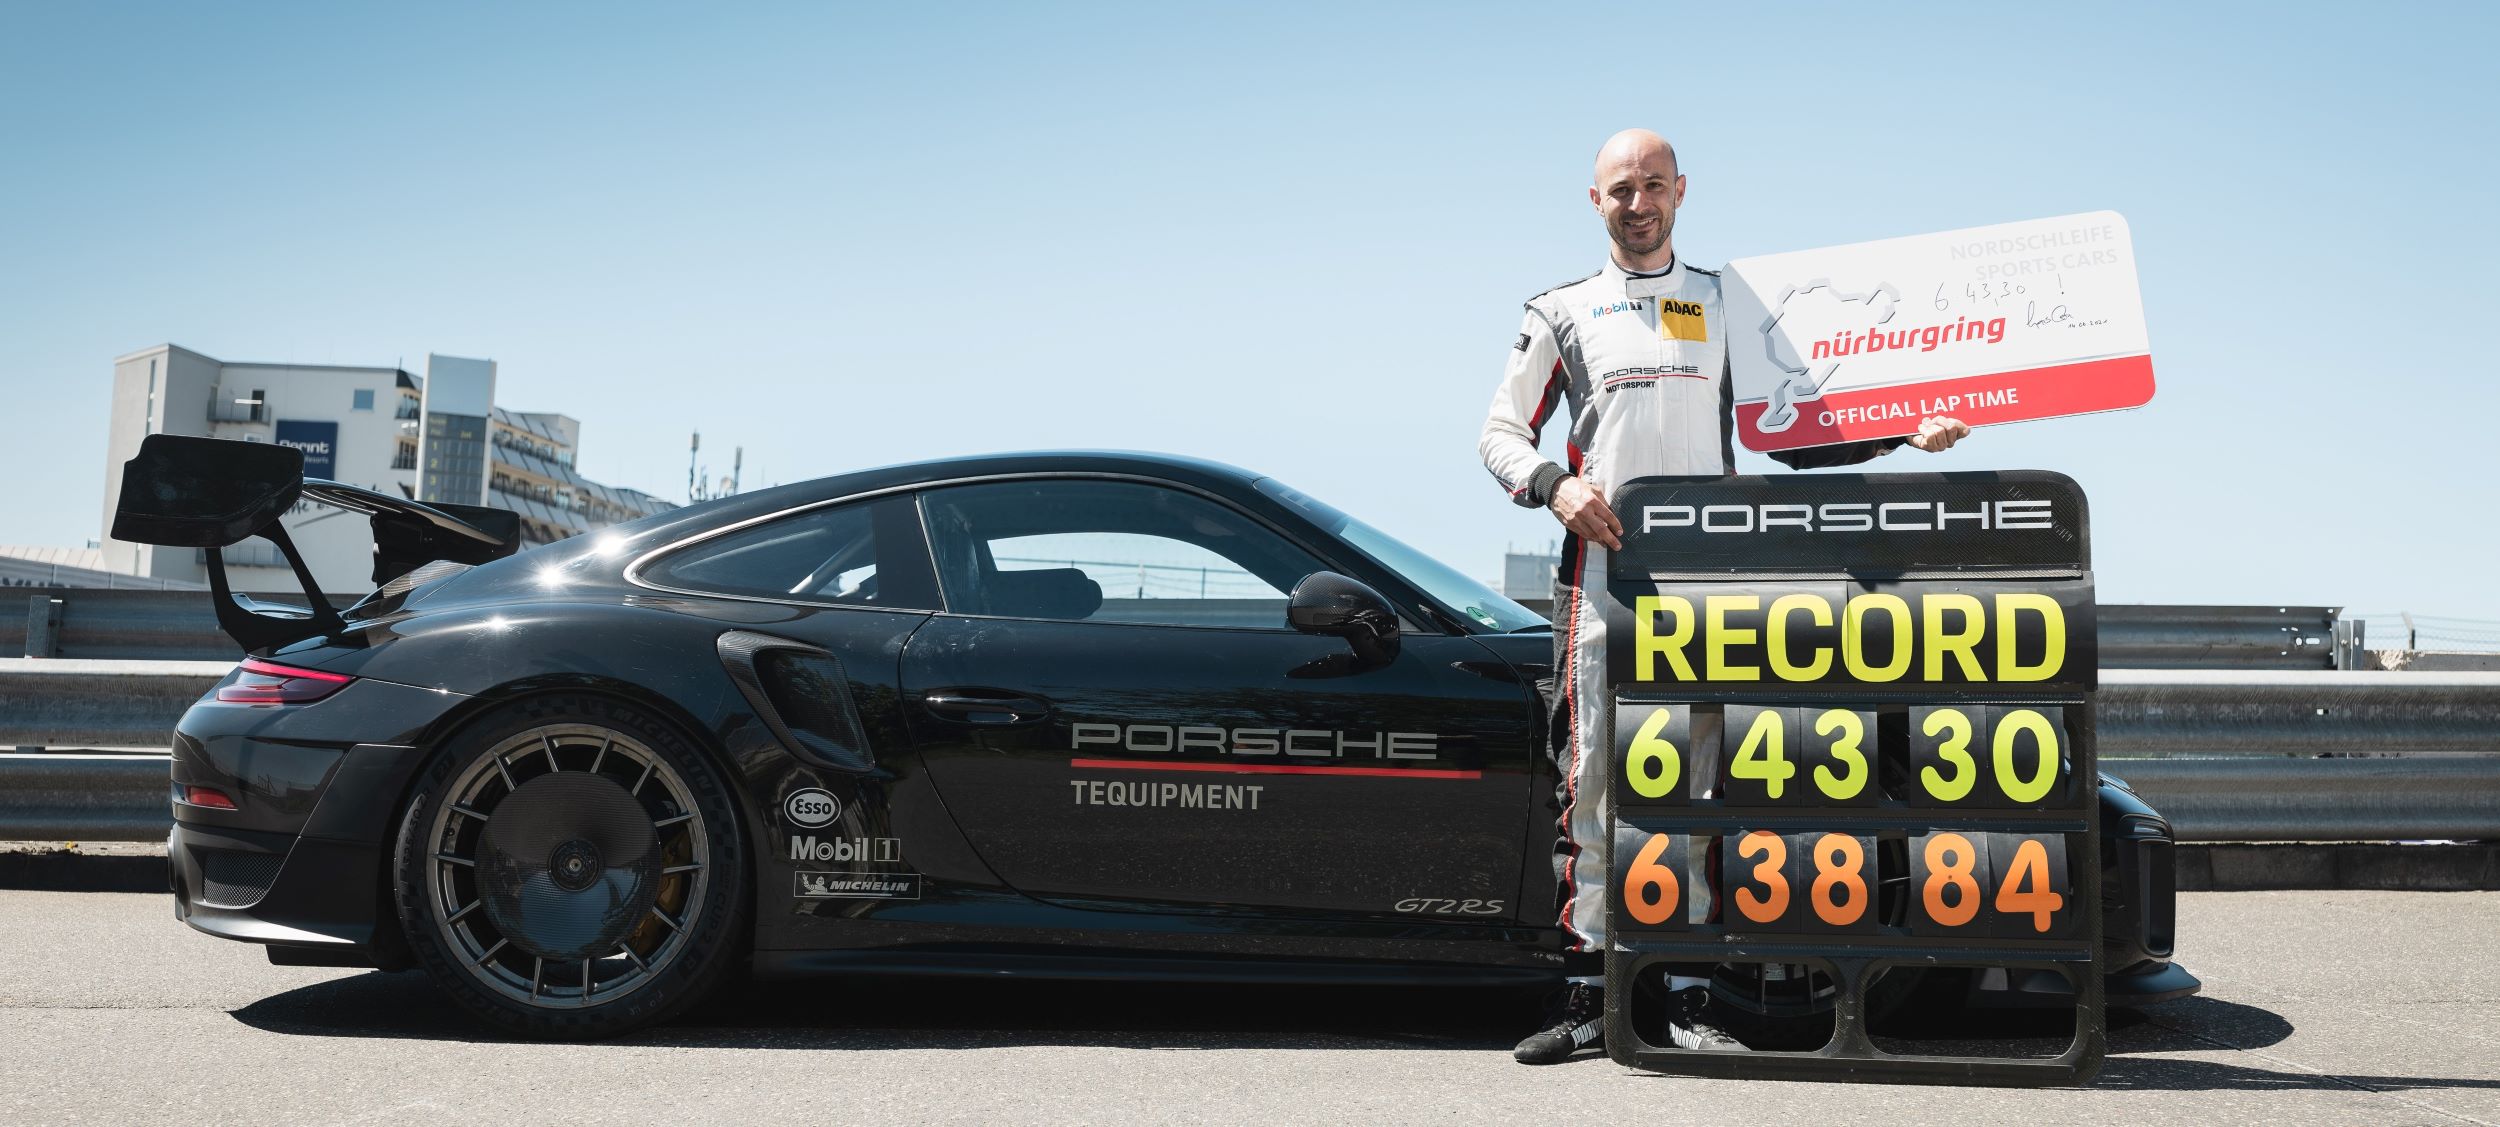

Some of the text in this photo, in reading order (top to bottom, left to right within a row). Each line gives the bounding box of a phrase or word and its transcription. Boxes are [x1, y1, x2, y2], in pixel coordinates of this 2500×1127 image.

[1950, 225, 2114, 260] NORDSCHLEIFE
[1975, 248, 2119, 281] SPORTS CARS
[1592, 301, 1628, 318] Mobil
[1663, 300, 1702, 317] ADAC
[1811, 315, 2006, 360] nürburgring
[1602, 365, 1699, 380] PORSCHE
[1605, 381, 1656, 394] MOTORSPORT
[1818, 388, 2019, 427] OFFICIAL LAP TIME
[1642, 500, 2053, 534] PORSCHE
[1634, 593, 2067, 683] RECORD
[610, 704, 716, 793] MICHELIN
[1071, 722, 1438, 760] PORSCHE
[1626, 707, 2059, 803] 6 43 30
[1070, 780, 1264, 810] TEQUIPMENT
[790, 835, 869, 862] Mobil
[829, 880, 910, 892] MICHELIN
[1624, 830, 2064, 933] 6 38 84
